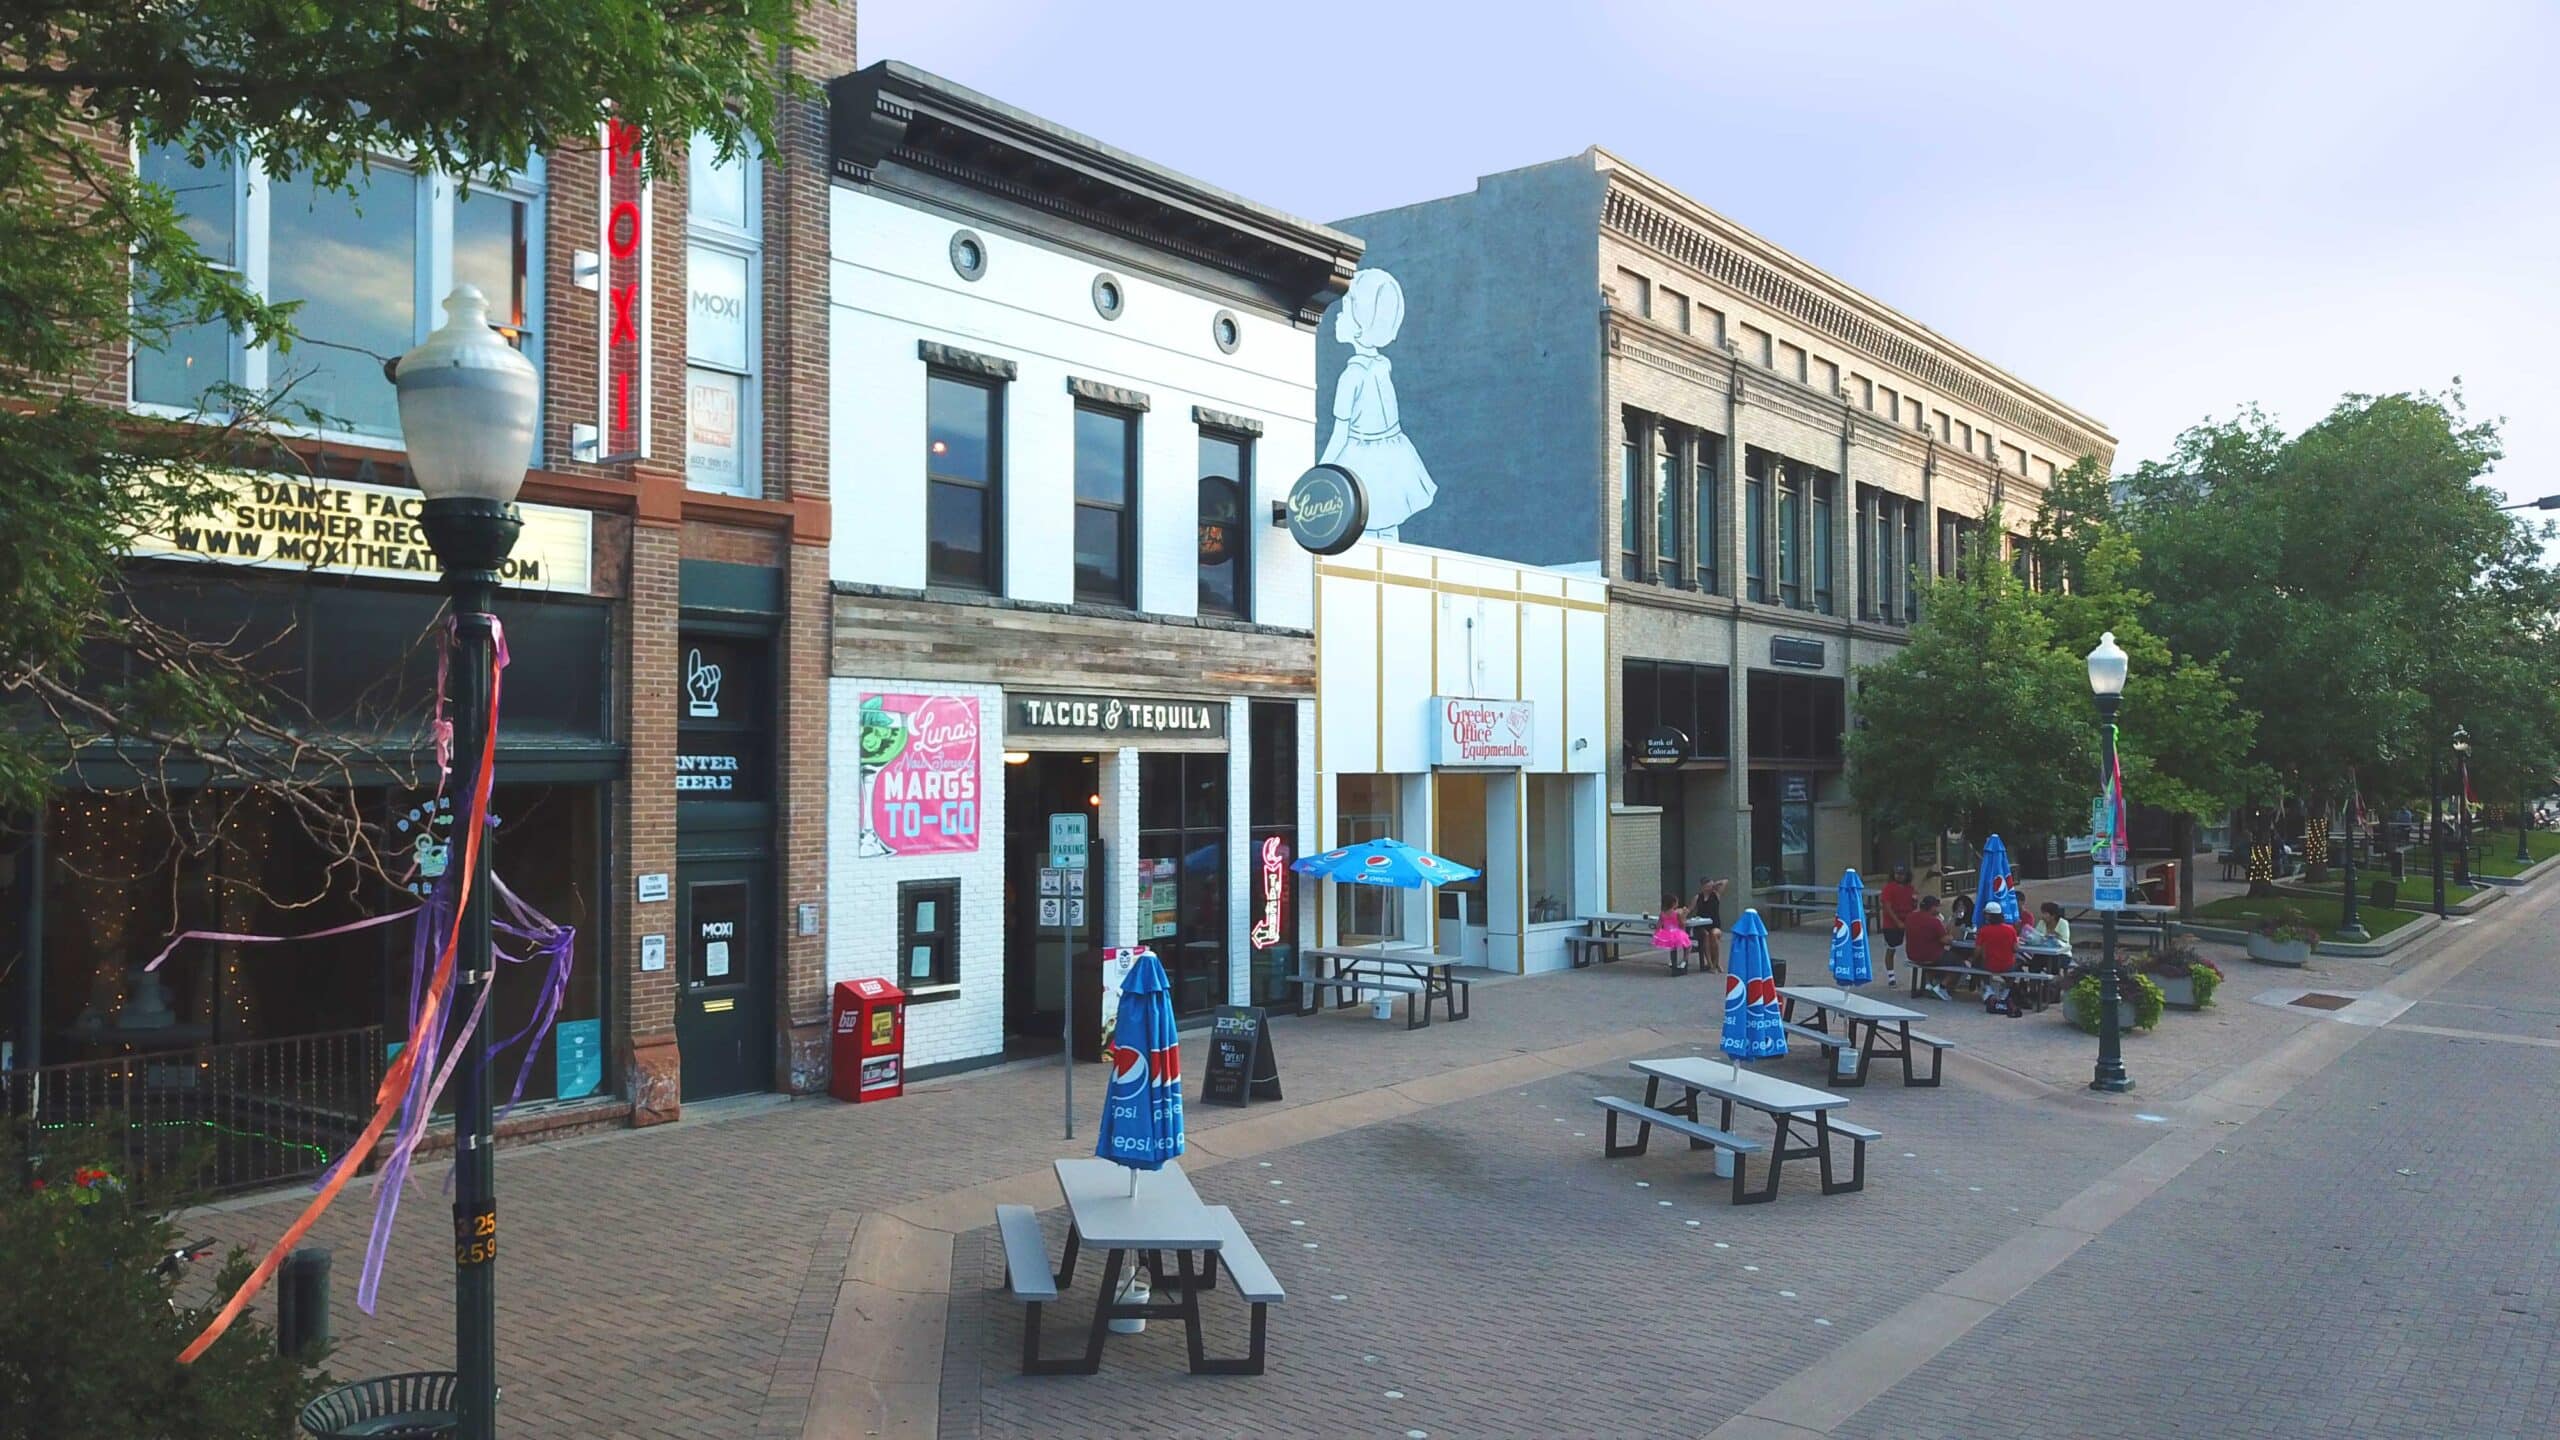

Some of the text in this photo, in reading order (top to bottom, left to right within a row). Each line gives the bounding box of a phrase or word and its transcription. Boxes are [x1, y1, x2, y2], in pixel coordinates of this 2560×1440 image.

[608, 117, 641, 431] MOXI
[692, 290, 740, 318] MOXI
[255, 481, 425, 520] DANCE FAC
[1294, 494, 1344, 522] Luna's
[236, 506, 363, 540] SUMMER
[174, 526, 262, 556] WWW
[499, 558, 540, 582] OM
[1028, 699, 1211, 731] TACOS & TEQUILA
[1447, 700, 1499, 730] Greeley
[913, 711, 977, 753] Luna's
[1453, 720, 1492, 745] Office
[1648, 738, 1664, 746] Bank
[1648, 747, 1680, 755] Colorado
[675, 775, 733, 790] HERE
[884, 771, 975, 801] MARGS
[884, 801, 975, 838] TO-GO
[1053, 844, 1085, 856] PARKING
[702, 921, 733, 937] MOXI
[1112, 1136, 1151, 1152] epsi
